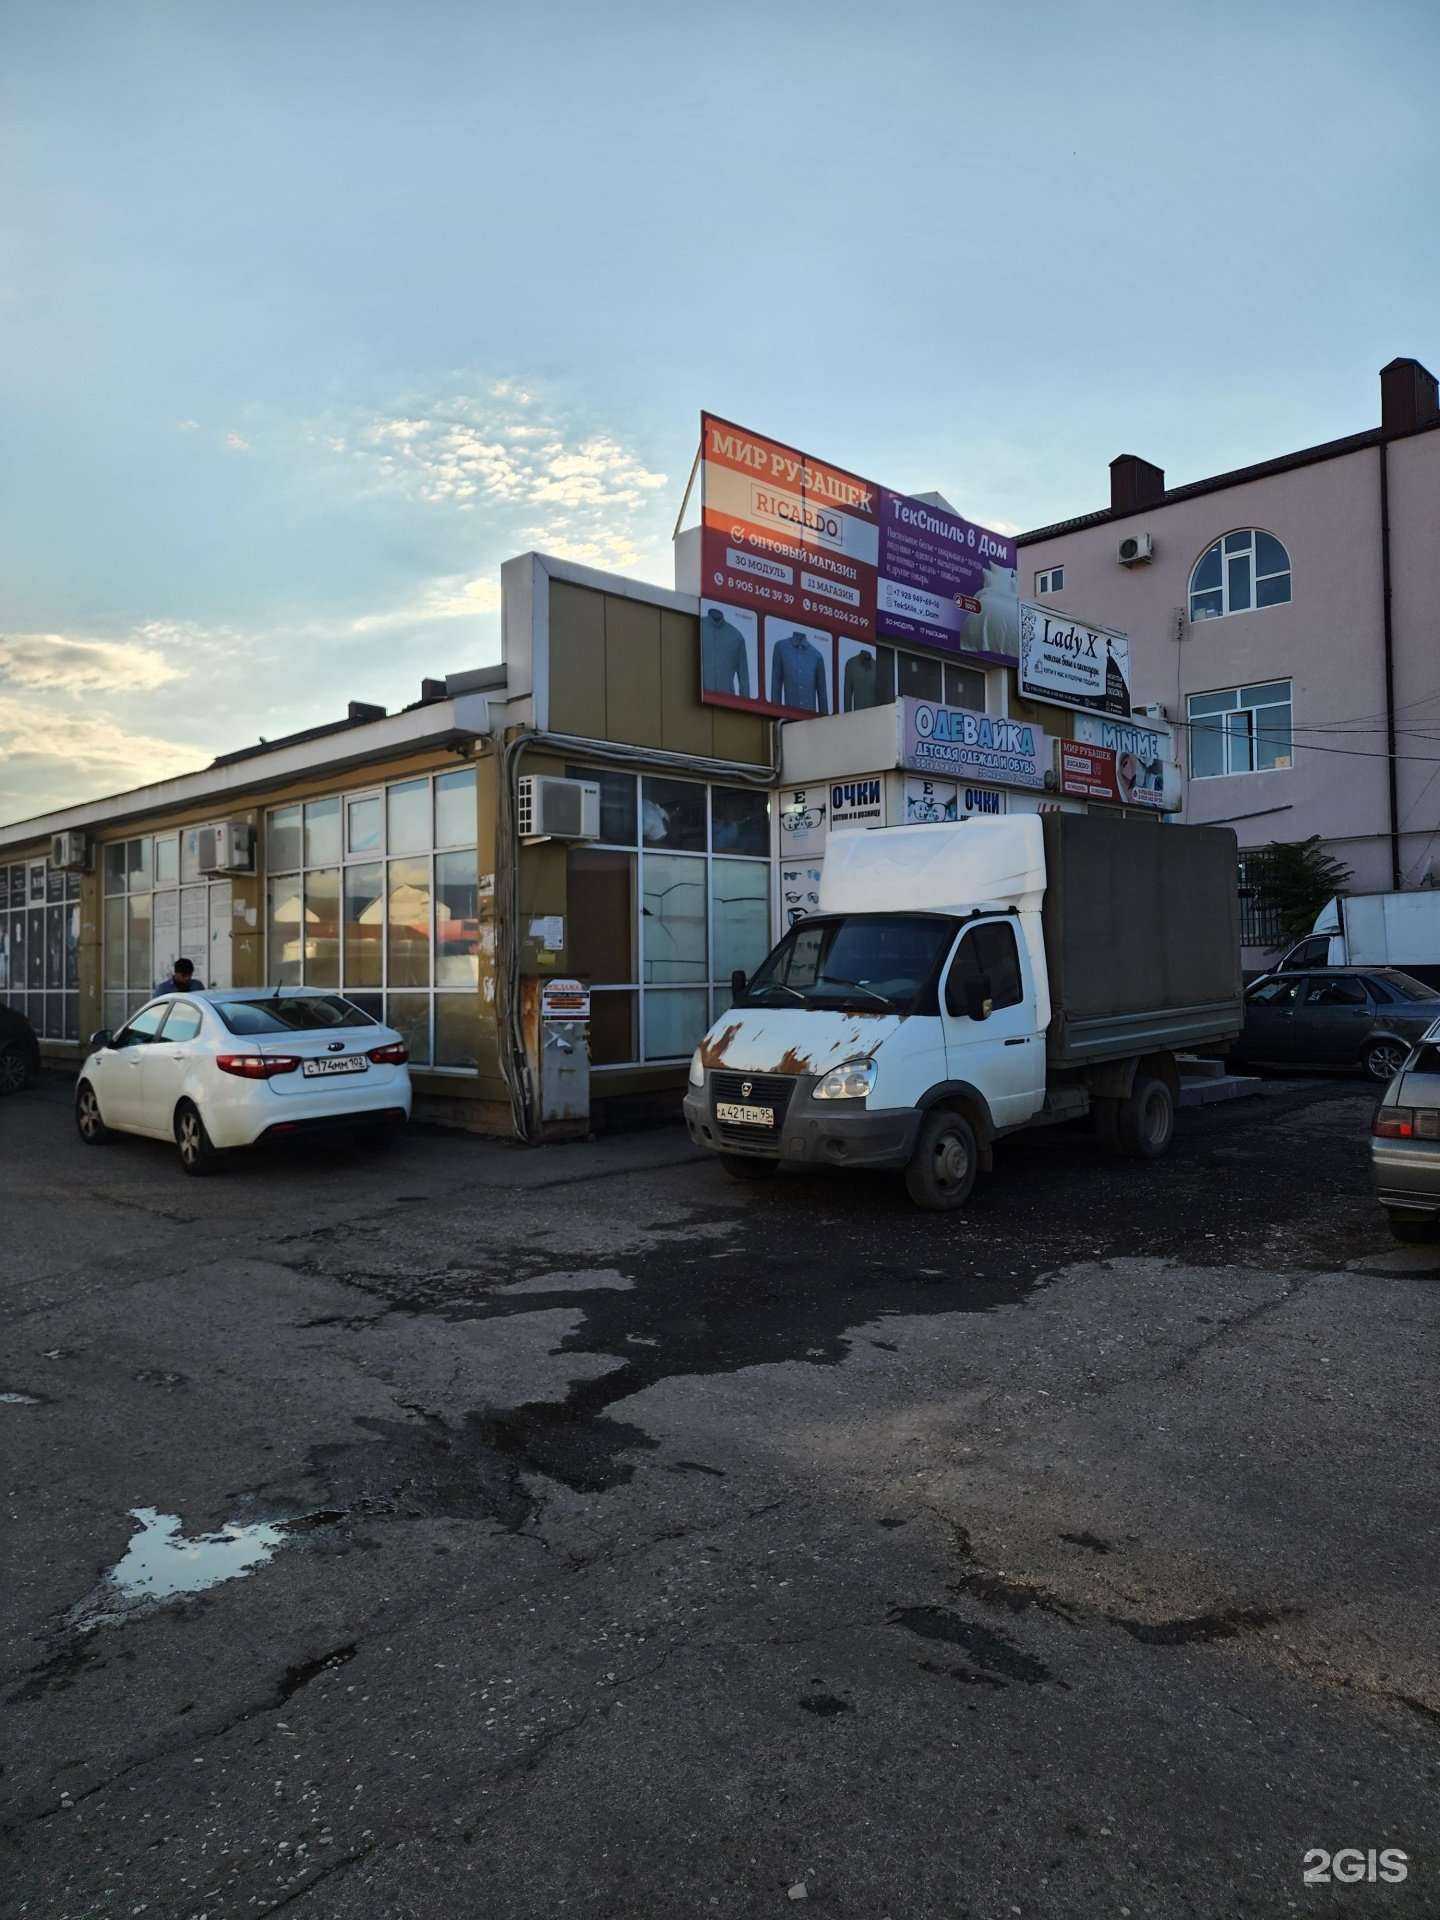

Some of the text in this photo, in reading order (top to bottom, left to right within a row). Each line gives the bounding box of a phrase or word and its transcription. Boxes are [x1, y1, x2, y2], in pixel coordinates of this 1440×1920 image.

[712, 430, 873, 513] МИР РУБАШЕК
[756, 492, 839, 538] RICARDO
[893, 499, 1008, 561] ТекСтиль в Дом
[735, 555, 787, 579] 30 МОДУЛЬ
[748, 533, 857, 580] ОПТОВЫЙ МАГАЗИН
[728, 577, 795, 605] 8 905 142 39 39
[816, 581, 854, 602] МАГАЗИН
[915, 705, 1036, 757] ОДЕВАЙКА
[916, 741, 960, 763] ДЕТСКАЯ
[960, 748, 999, 769] ОДЕЖДА
[1000, 756, 1008, 768] И
[1008, 758, 1036, 775] ОБУВЬ
[1063, 742, 1112, 761] МИР РУБАШЕК
[832, 780, 880, 809] ОЧКИ
[965, 788, 1000, 814] ОЧКИ
[721, 1106, 771, 1120] А421ЕН 95
